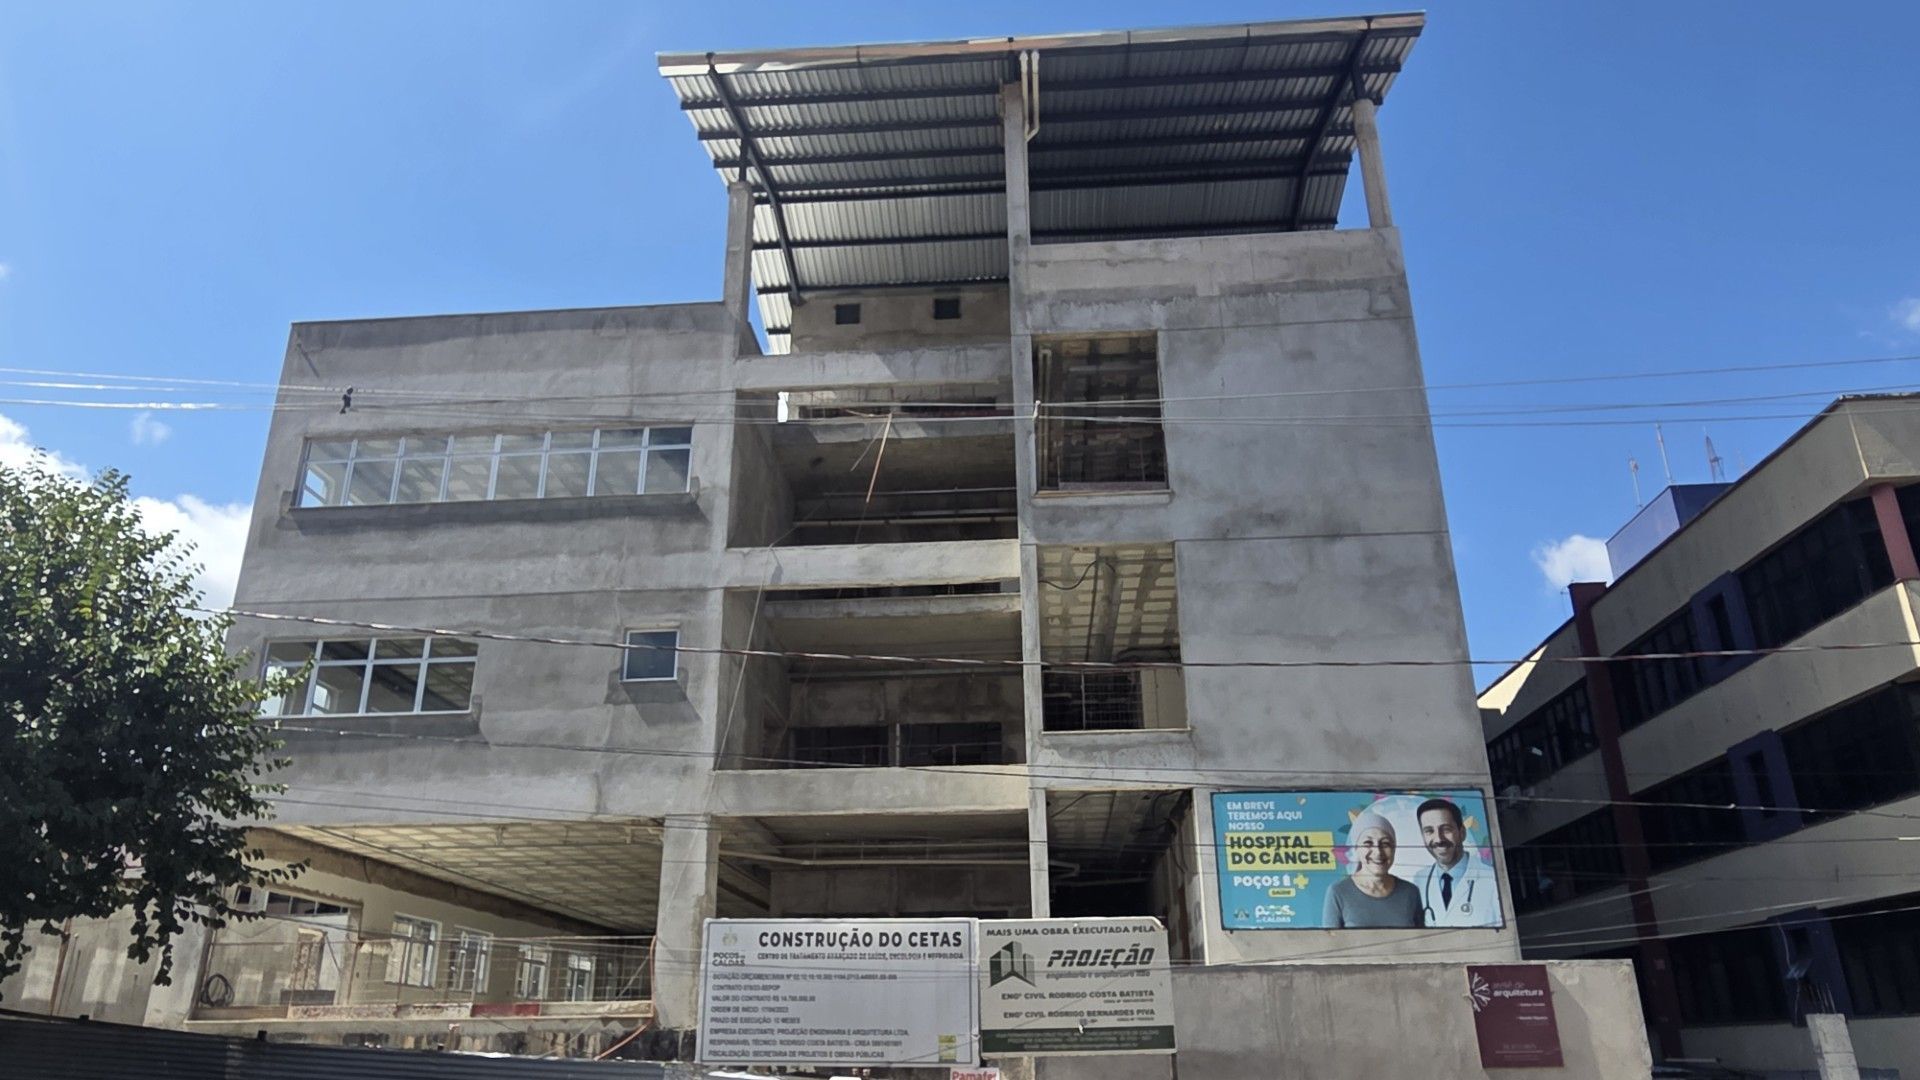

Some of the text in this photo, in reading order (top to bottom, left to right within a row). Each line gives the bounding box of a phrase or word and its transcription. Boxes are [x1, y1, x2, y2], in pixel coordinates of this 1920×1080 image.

[1226, 801, 1275, 810] EM BREVE
[1228, 811, 1302, 820] TEREMOS AQUI
[1228, 822, 1264, 830] NOSSO
[1230, 836, 1312, 848] HOSPITAL
[1231, 848, 1330, 864] DO CÂNCER
[1233, 876, 1280, 889] POÇOS
[1015, 928, 1038, 936] UMA
[1042, 927, 1069, 935] OBRA
[1072, 926, 1130, 935] EXECUTADA
[1132, 925, 1155, 933] PELA
[758, 928, 962, 951] CONSTRUÇÃO DO CETAS
[757, 952, 779, 960] CENTRO
[790, 952, 826, 960] TRATAMENTO
[1047, 943, 1155, 968] PROJEÇÃO
[1493, 989, 1544, 999] arquitetura
[1087, 1009, 1134, 1017] BERNARDES
